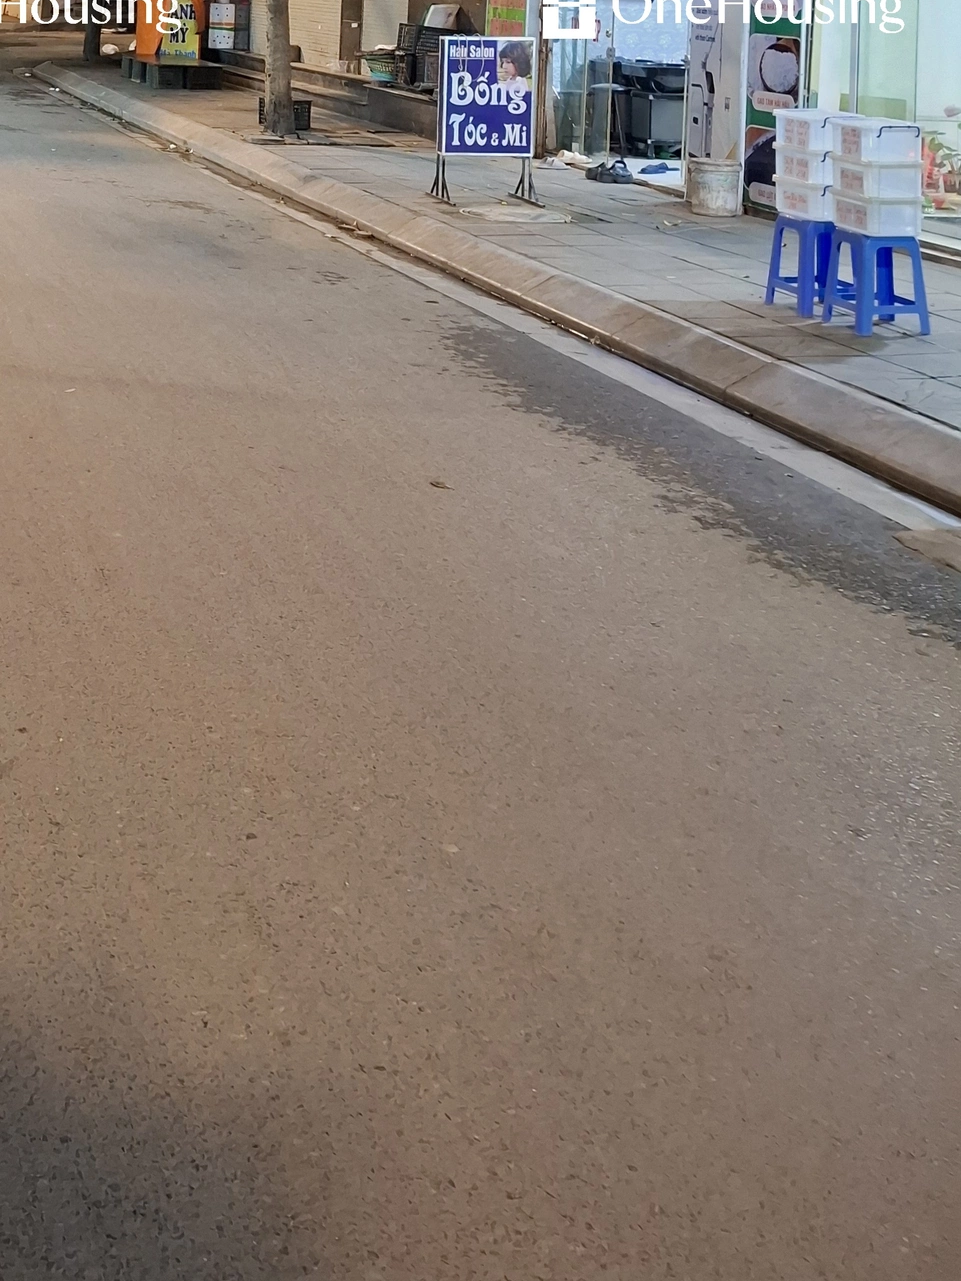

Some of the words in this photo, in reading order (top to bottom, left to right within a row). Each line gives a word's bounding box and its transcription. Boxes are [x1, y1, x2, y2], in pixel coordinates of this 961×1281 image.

[449, 45, 468, 58] Hair
[469, 45, 495, 58] Salon
[449, 72, 527, 115] Bống
[449, 113, 487, 146] Tóc
[490, 132, 499, 146] &
[502, 123, 527, 147] Mi
